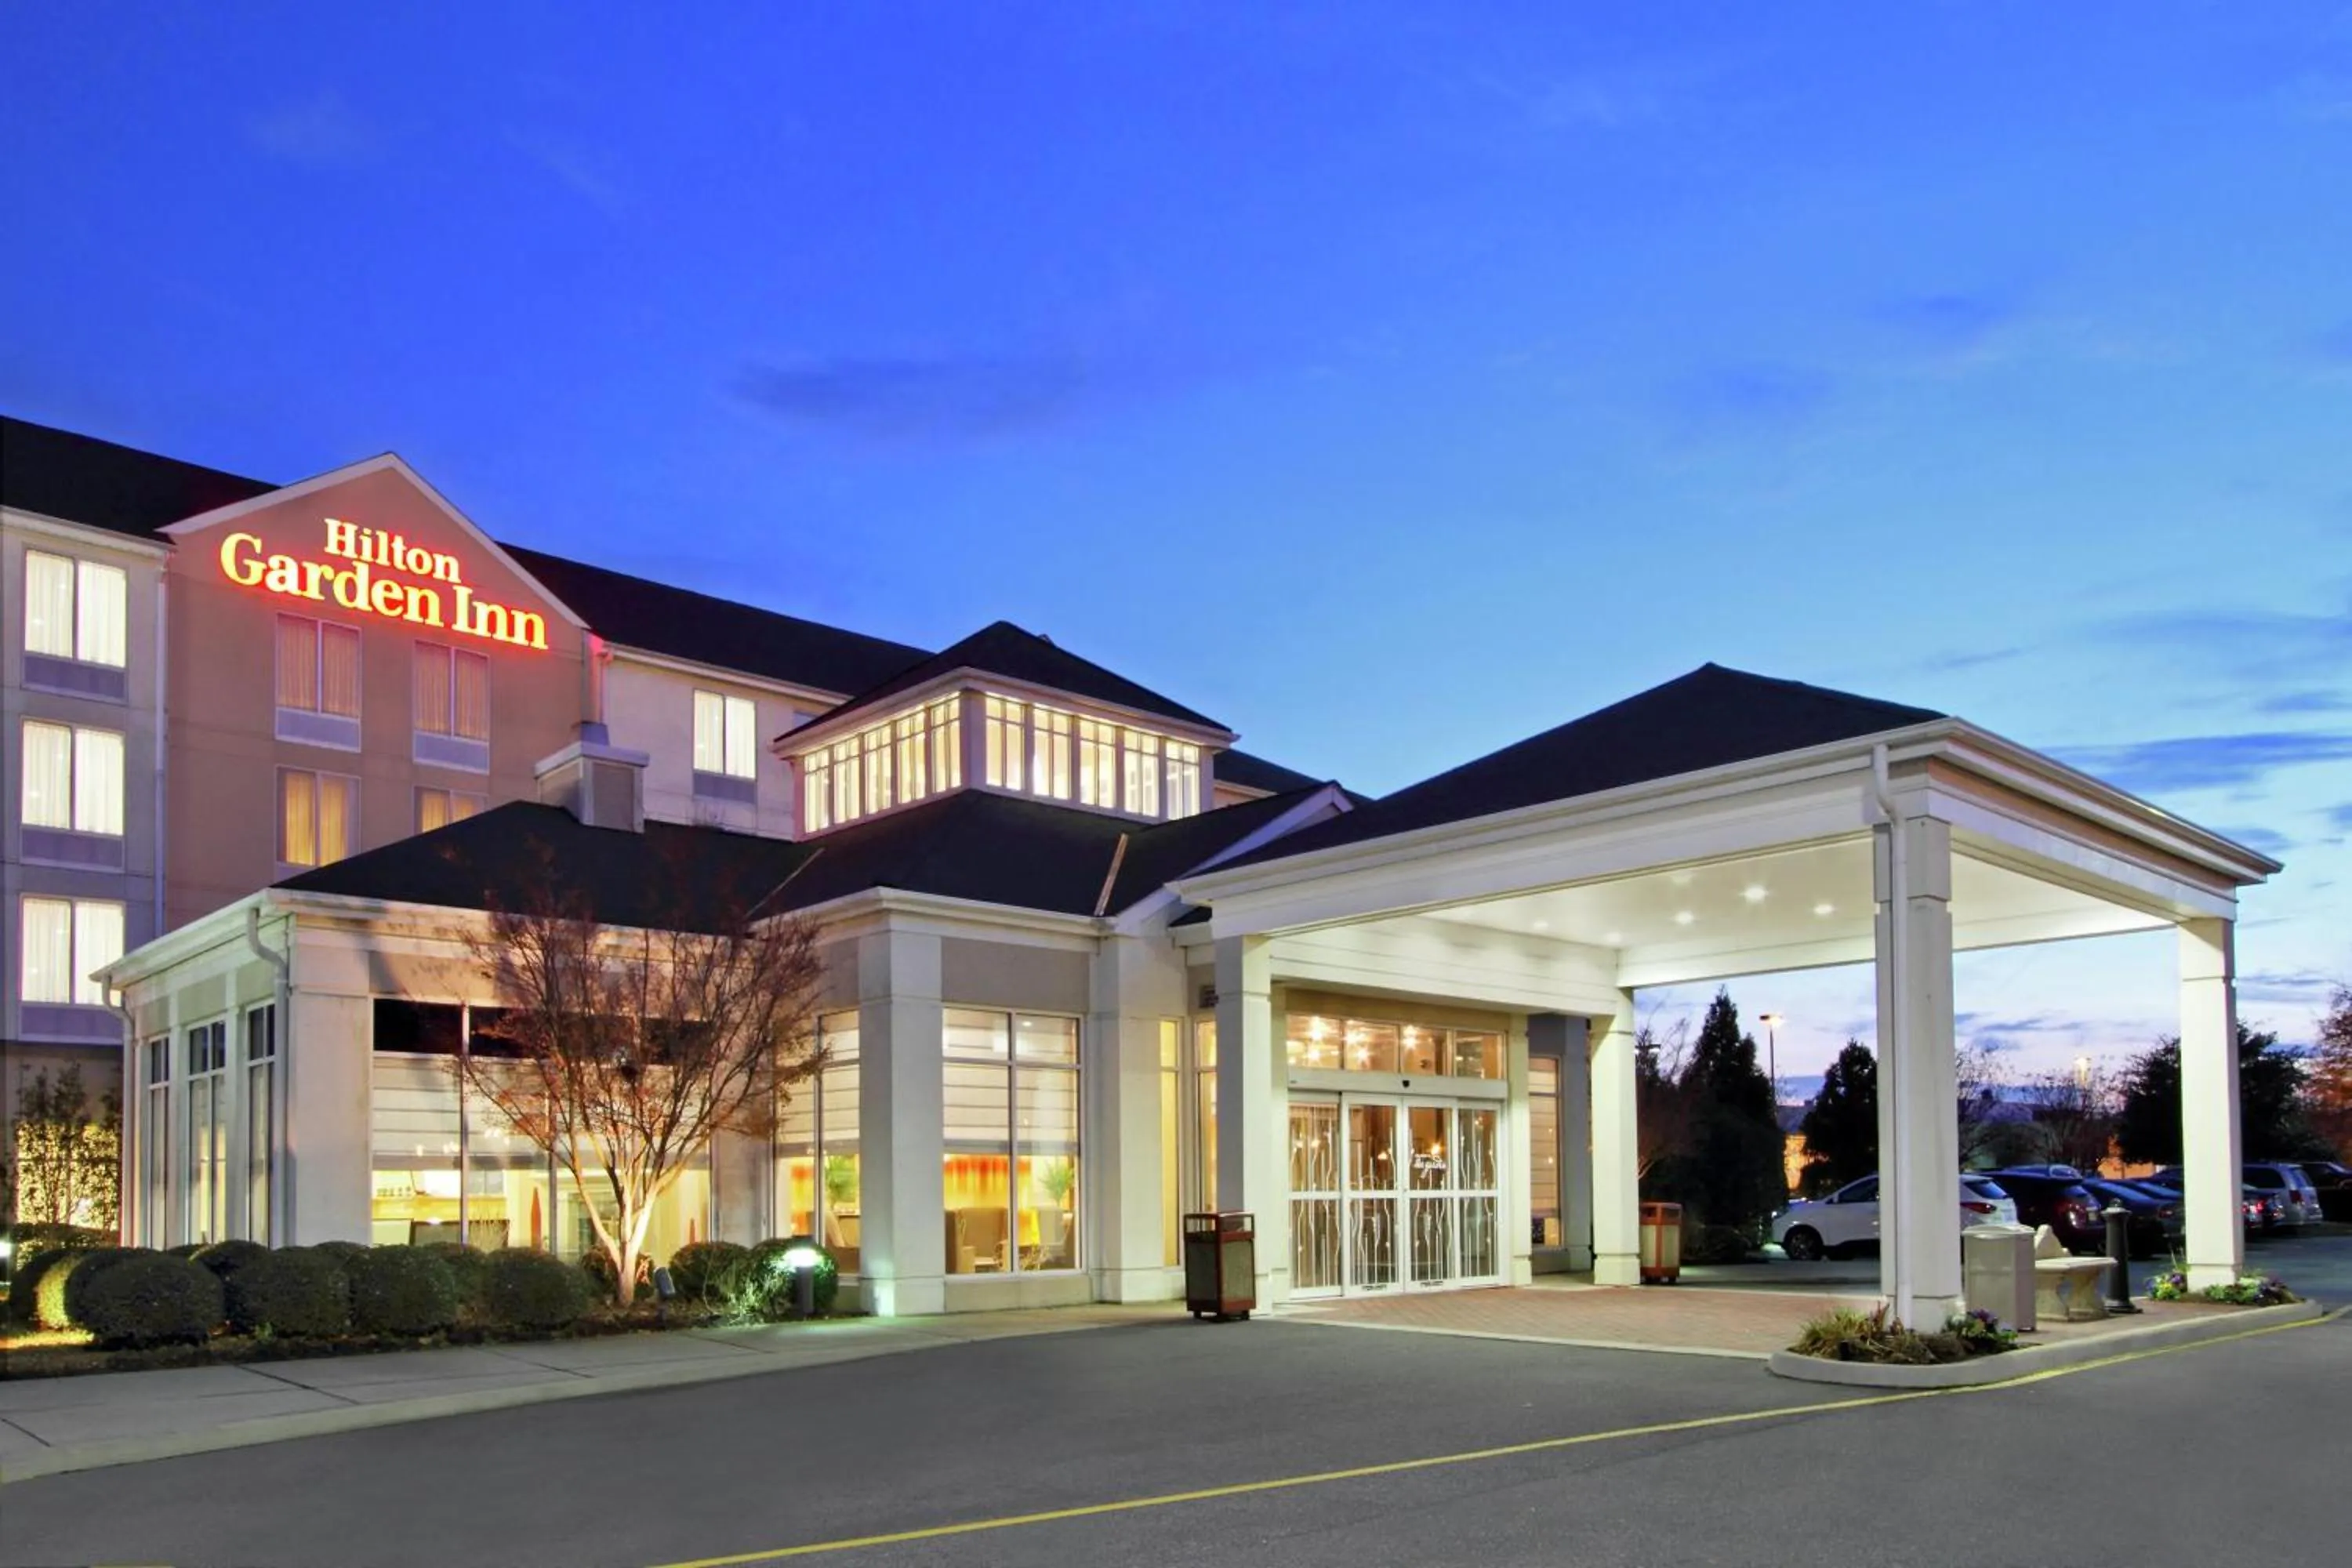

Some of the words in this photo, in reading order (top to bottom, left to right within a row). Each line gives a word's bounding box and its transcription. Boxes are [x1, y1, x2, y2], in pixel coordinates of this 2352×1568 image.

[220, 533, 444, 627] Garden
[452, 585, 548, 649] Inn
[324, 518, 461, 583] Hilton
